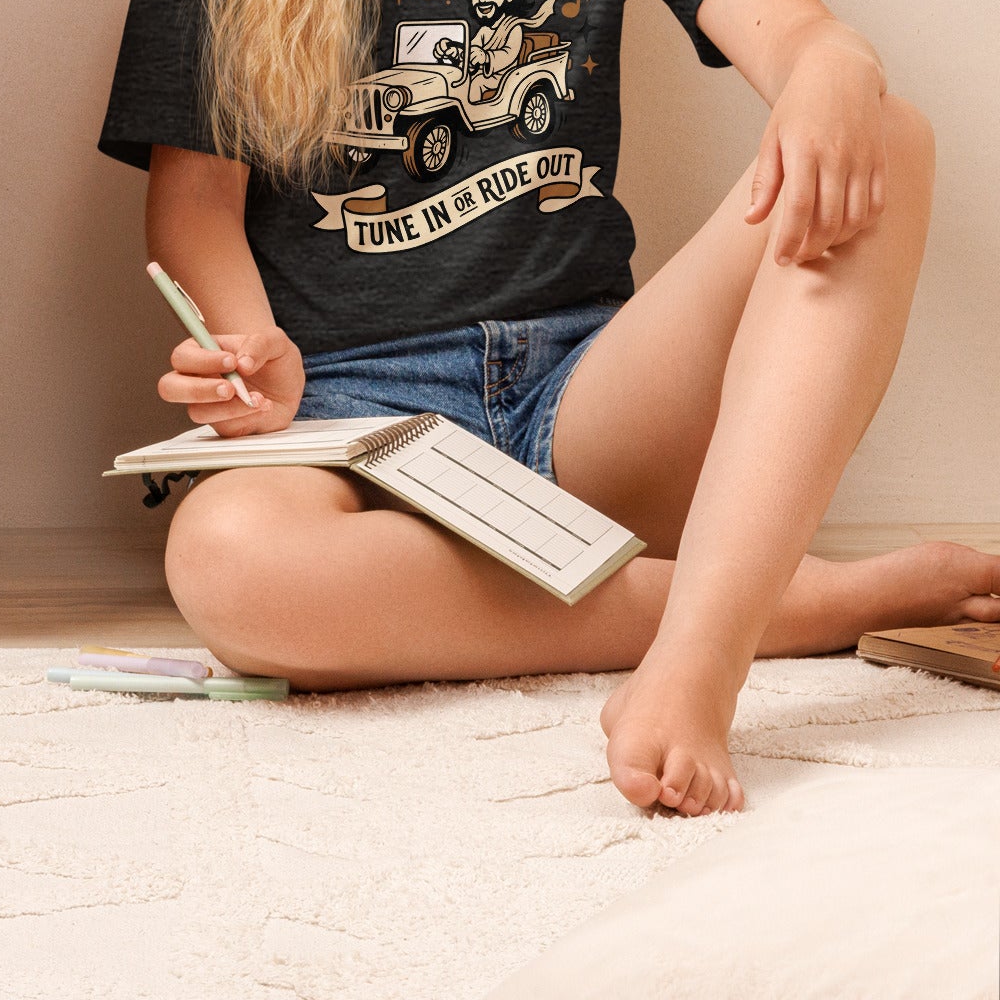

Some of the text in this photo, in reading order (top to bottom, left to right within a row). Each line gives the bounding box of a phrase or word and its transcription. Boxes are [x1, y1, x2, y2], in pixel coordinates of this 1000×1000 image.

[354, 153, 575, 246] TUNE IN OR RIDE OUT
